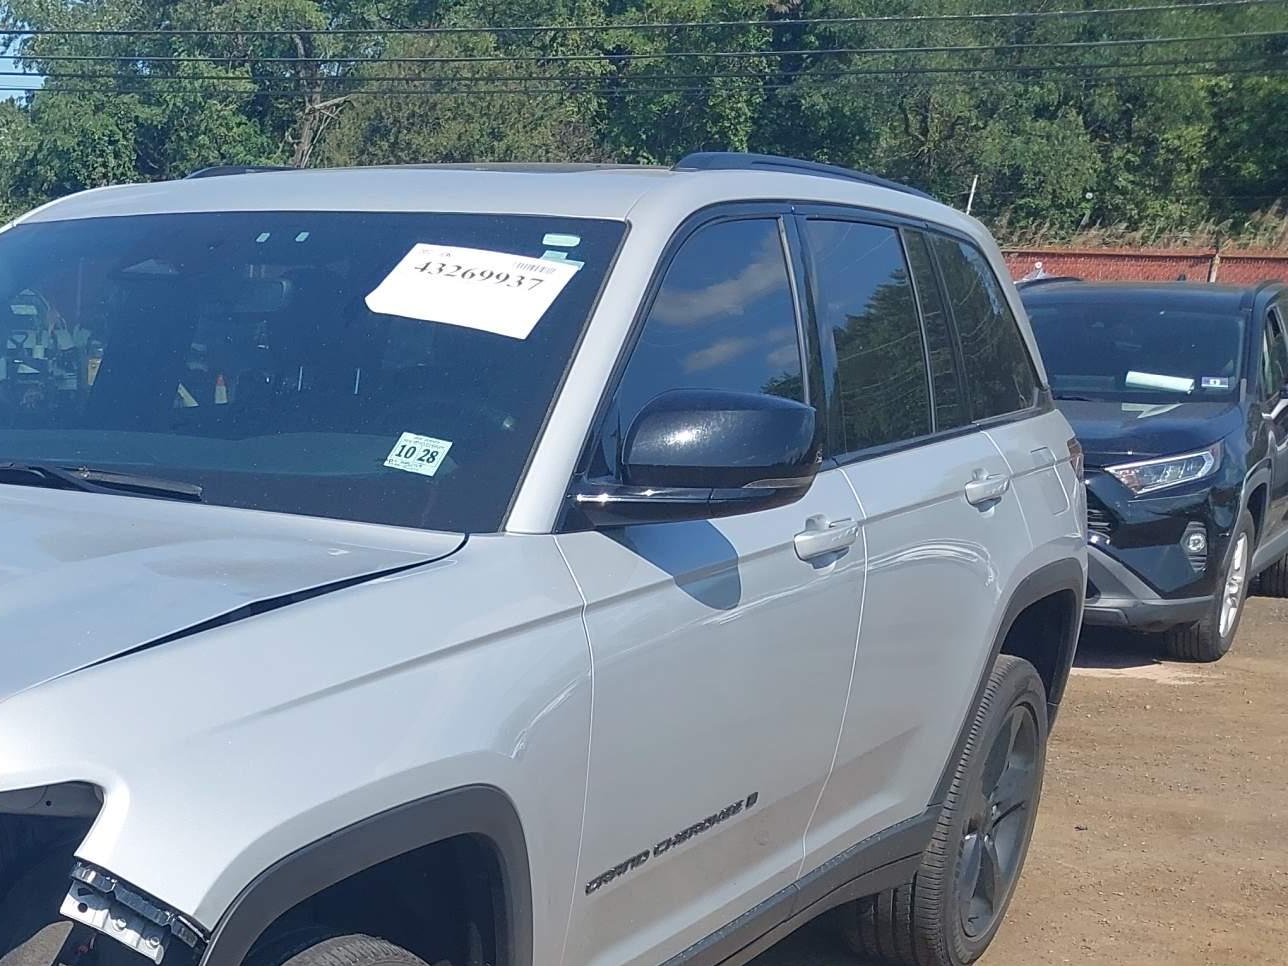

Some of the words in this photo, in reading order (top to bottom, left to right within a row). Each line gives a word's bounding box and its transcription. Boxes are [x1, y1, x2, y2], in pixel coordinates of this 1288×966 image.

[414, 260, 544, 291] 43269937
[395, 444, 417, 459] 10
[417, 448, 439, 464] 28
